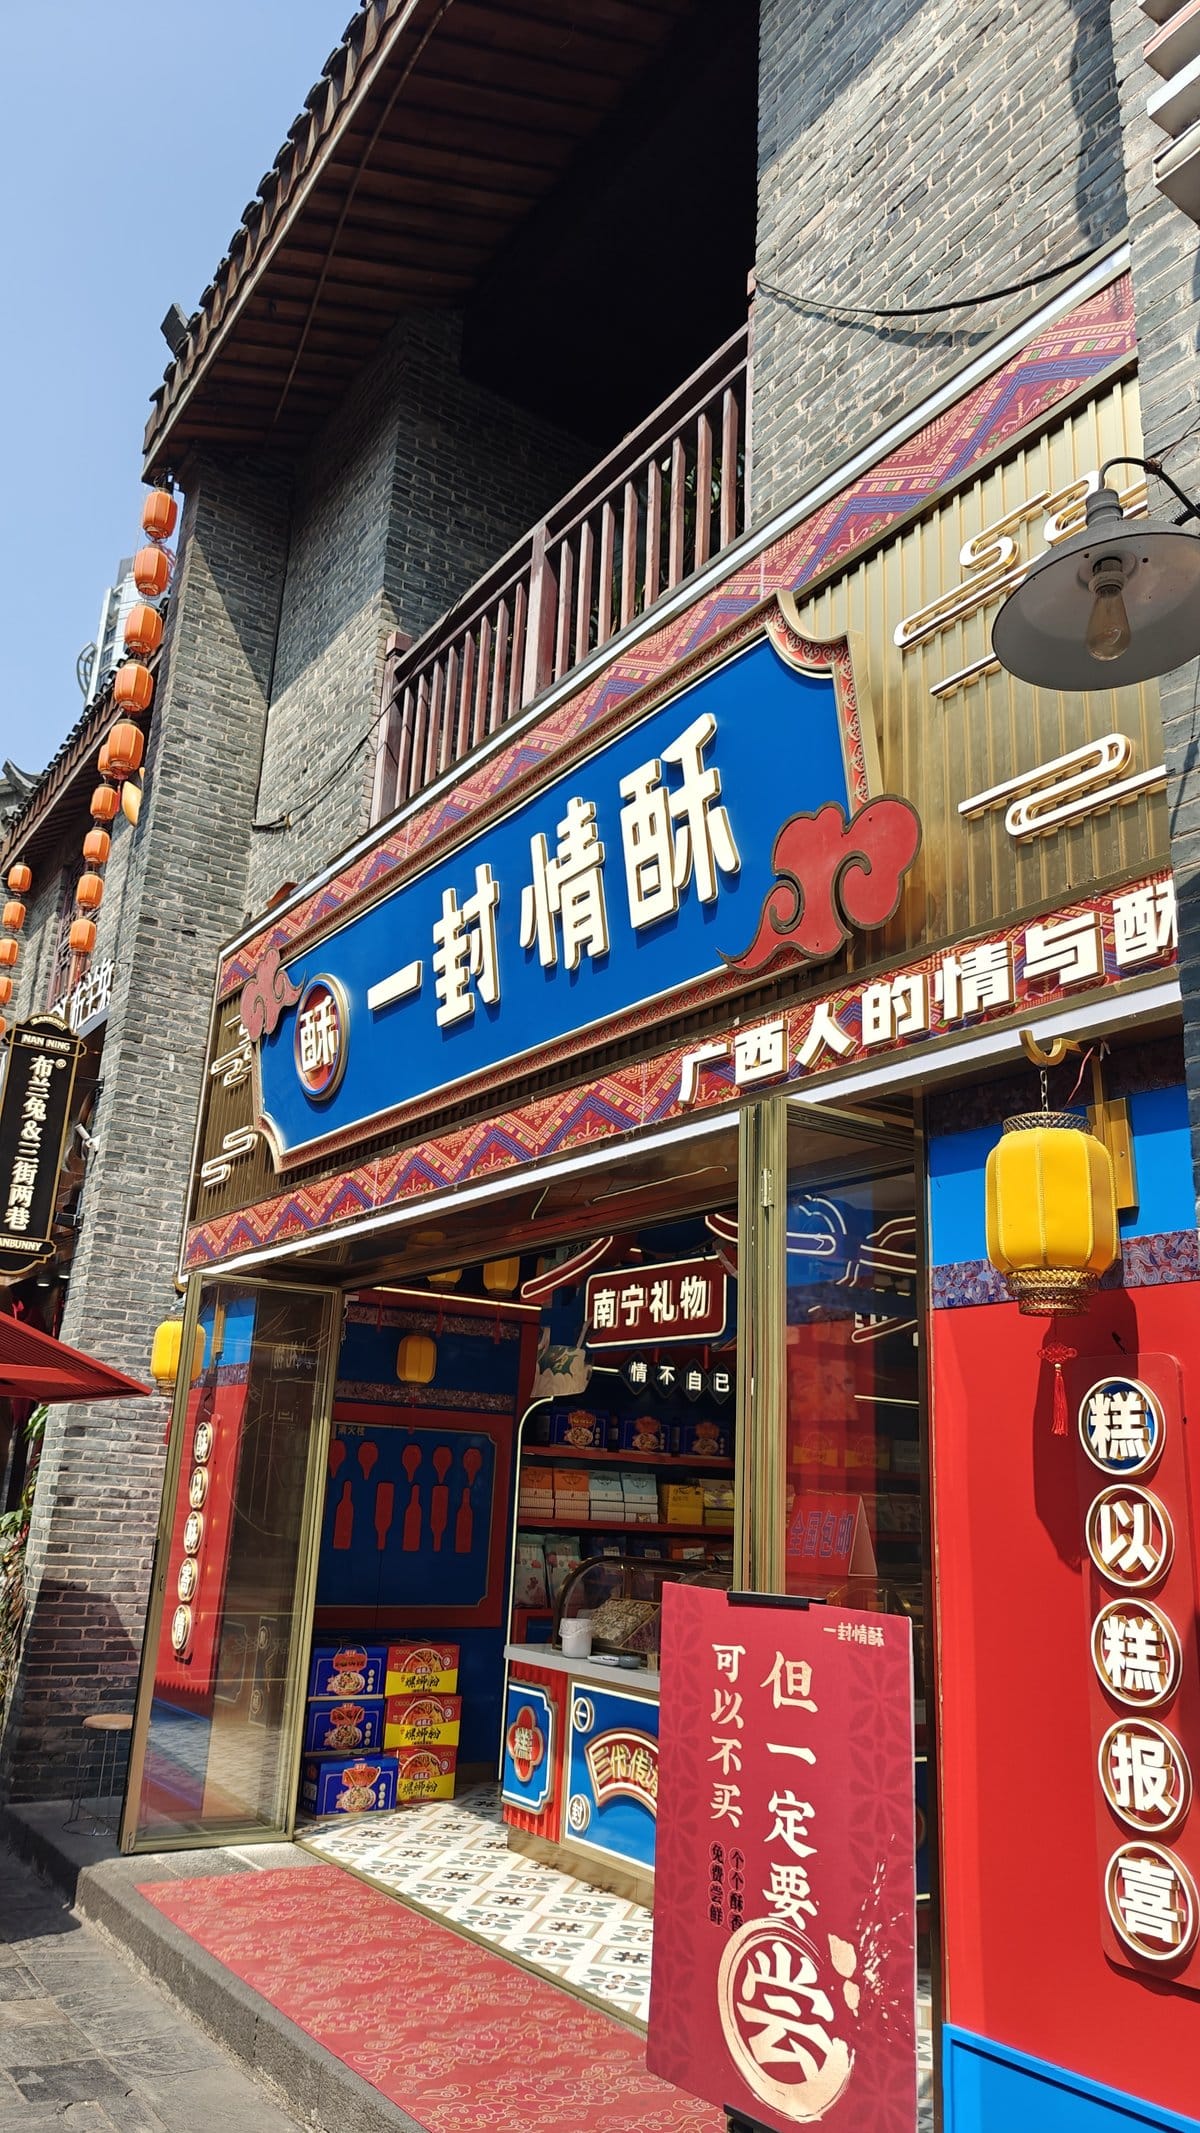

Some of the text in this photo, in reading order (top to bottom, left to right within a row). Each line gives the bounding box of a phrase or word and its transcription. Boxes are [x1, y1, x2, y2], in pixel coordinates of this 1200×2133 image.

[367, 713, 741, 1027] 一封情酥
[21, 1034, 71, 1052] NAN NING
[300, 995, 337, 1073] 酥
[592, 1276, 709, 1329] 南宁礼物
[823, 1622, 885, 1647] 一封情酥
[707, 1643, 747, 1828] 可以不买
